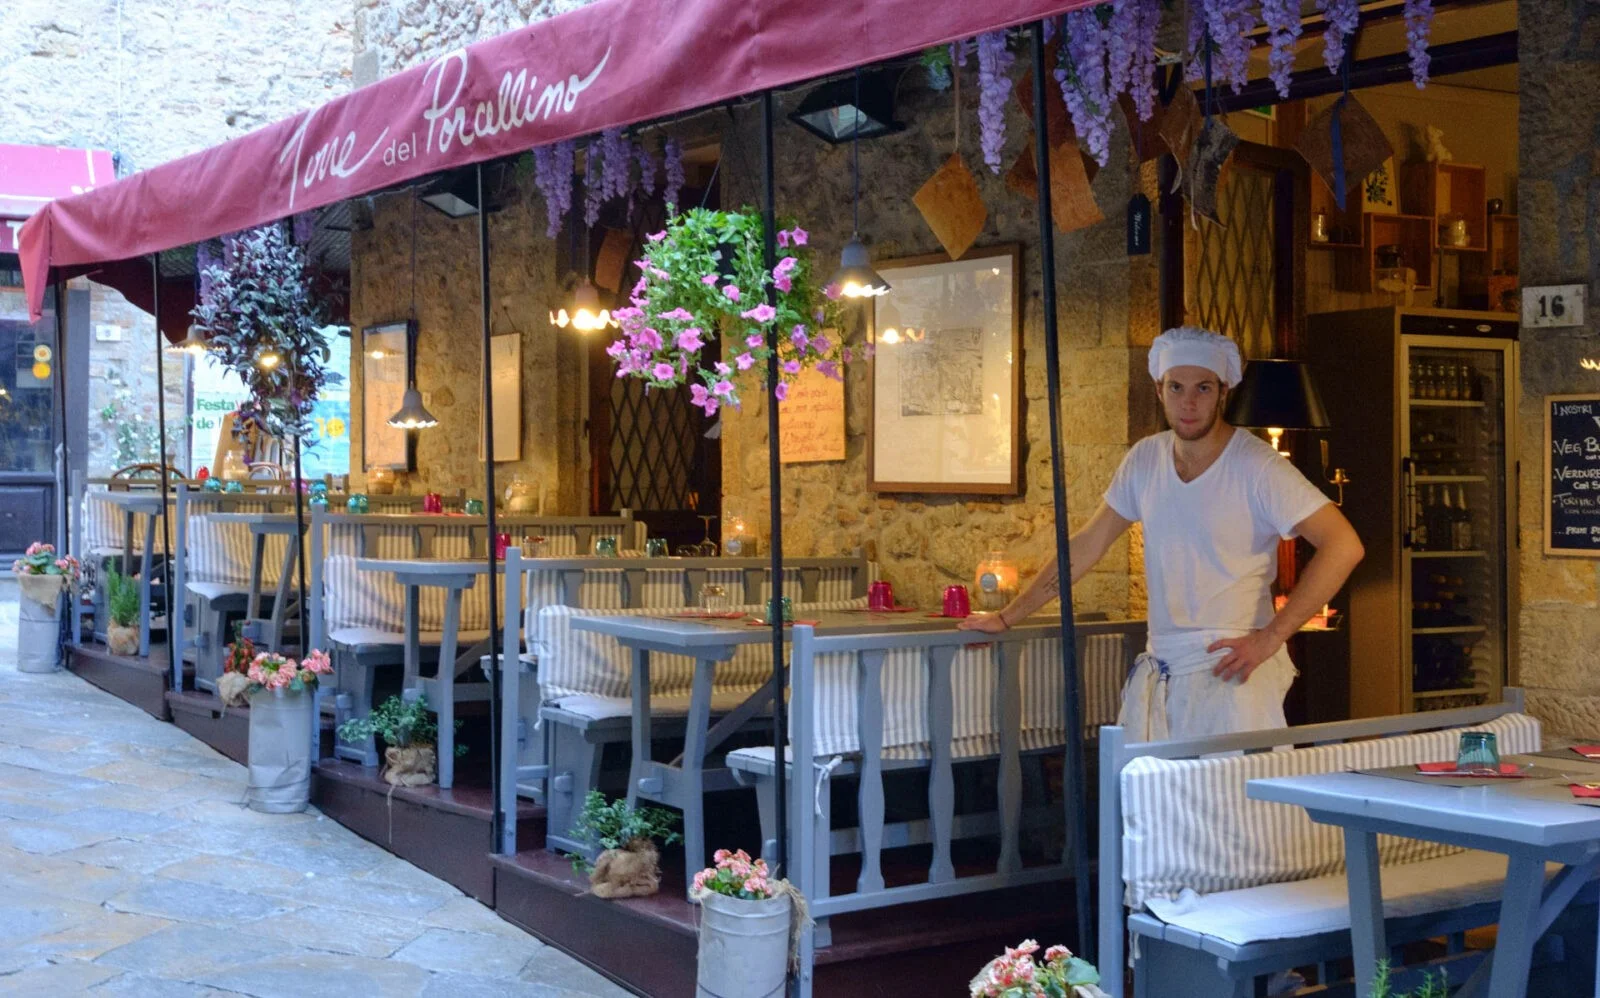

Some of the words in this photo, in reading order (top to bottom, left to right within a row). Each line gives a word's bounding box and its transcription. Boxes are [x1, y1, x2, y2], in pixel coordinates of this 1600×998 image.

[382, 141, 417, 167] del
[1538, 294, 1565, 319] 16
[196, 398, 235, 411] Festa
[1559, 404, 1593, 417] NOSTRI
[196, 416, 214, 430] de
